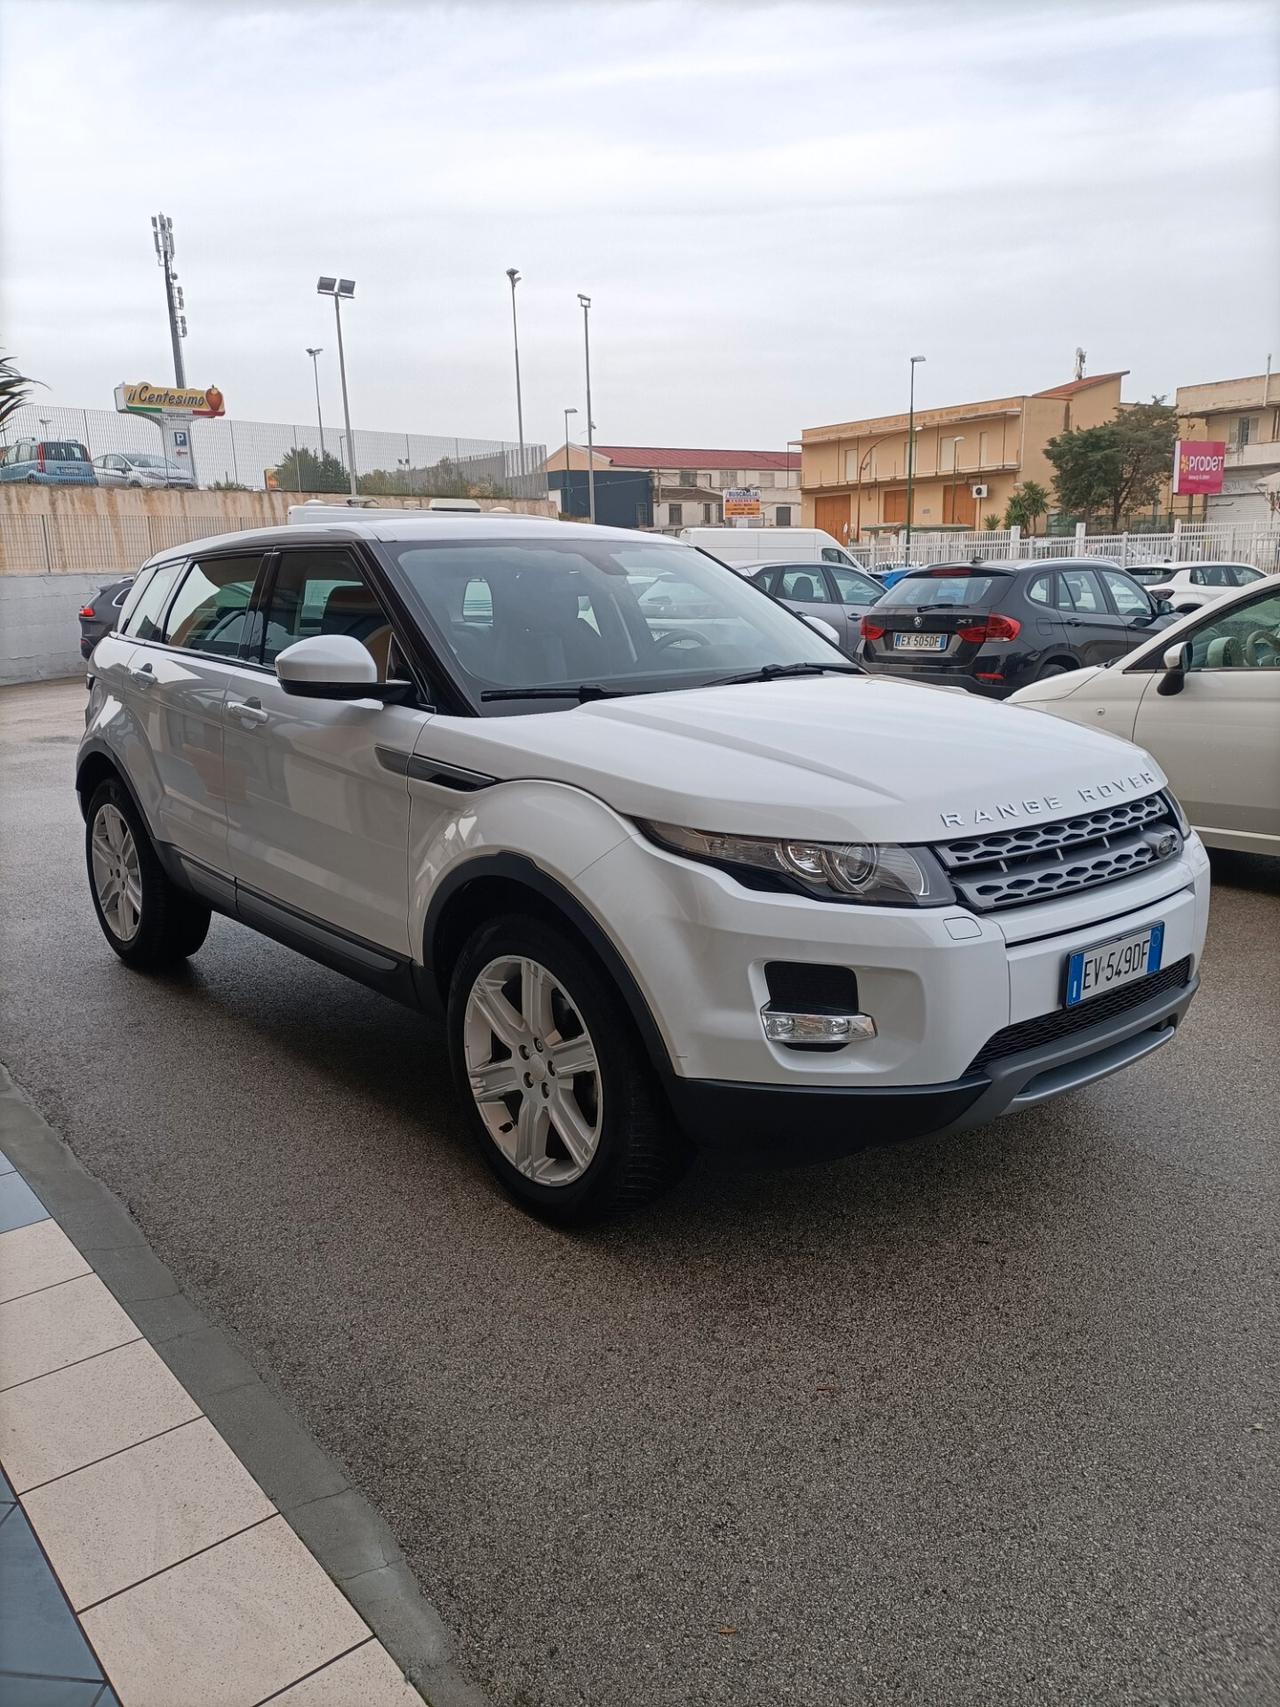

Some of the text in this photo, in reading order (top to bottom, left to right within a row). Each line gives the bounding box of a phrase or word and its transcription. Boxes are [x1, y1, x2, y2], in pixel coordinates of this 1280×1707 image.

[127, 385, 205, 406] il Centesimo
[901, 635, 940, 647] EX 505DF
[941, 772, 1155, 828] RANGE ROVER
[1082, 938, 1151, 991] EV 549DF
